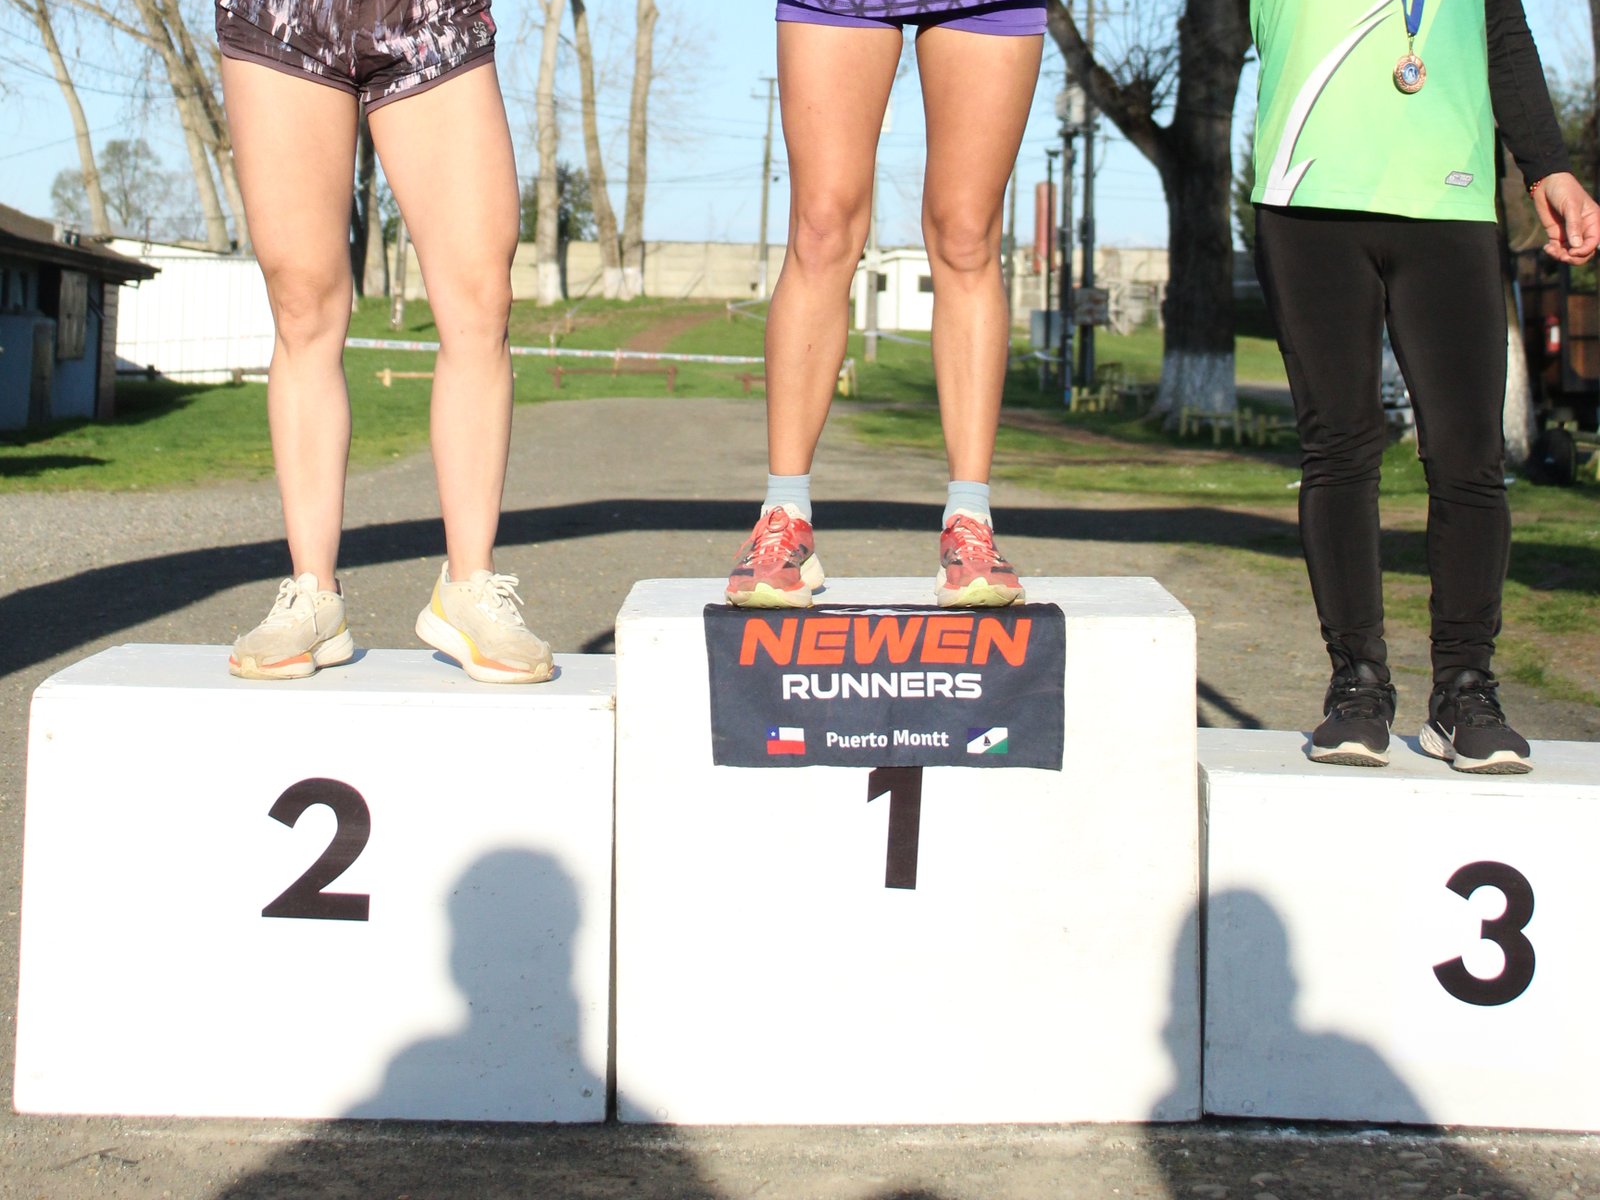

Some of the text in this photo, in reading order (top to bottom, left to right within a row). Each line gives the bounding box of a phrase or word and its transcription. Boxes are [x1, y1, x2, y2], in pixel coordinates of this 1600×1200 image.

[739, 617, 1032, 667] NEWEN
[782, 672, 982, 700] RUNNERS
[826, 730, 949, 748] Puerto Montt
[262, 777, 371, 922] 2
[866, 767, 923, 890] 1
[1432, 860, 1536, 1007] 3
